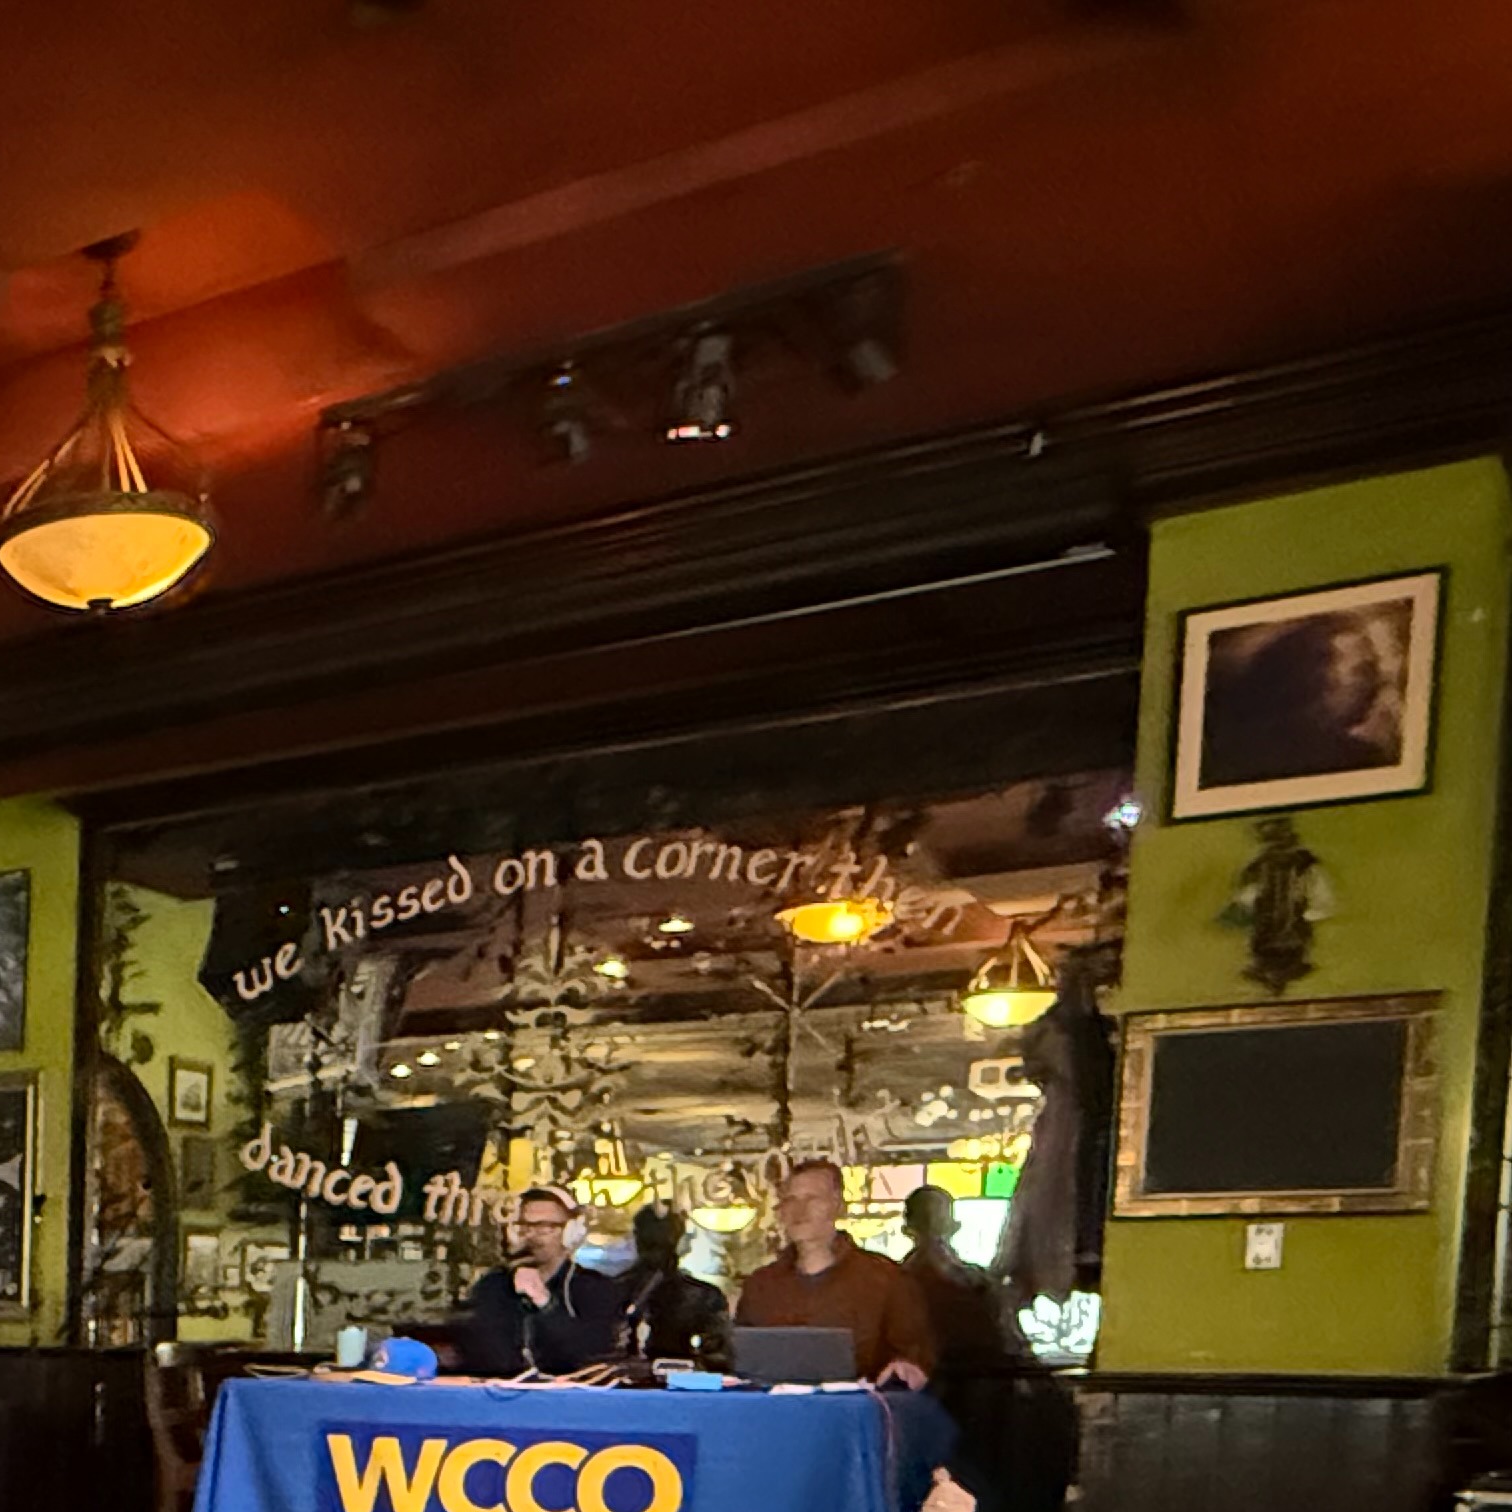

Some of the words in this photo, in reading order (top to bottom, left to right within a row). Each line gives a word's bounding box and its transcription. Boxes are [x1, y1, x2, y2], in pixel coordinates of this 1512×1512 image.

[231, 941, 304, 1000] we
[320, 854, 473, 951] kissed
[494, 849, 557, 896] on
[575, 837, 609, 881] a
[239, 1119, 404, 1214] danced
